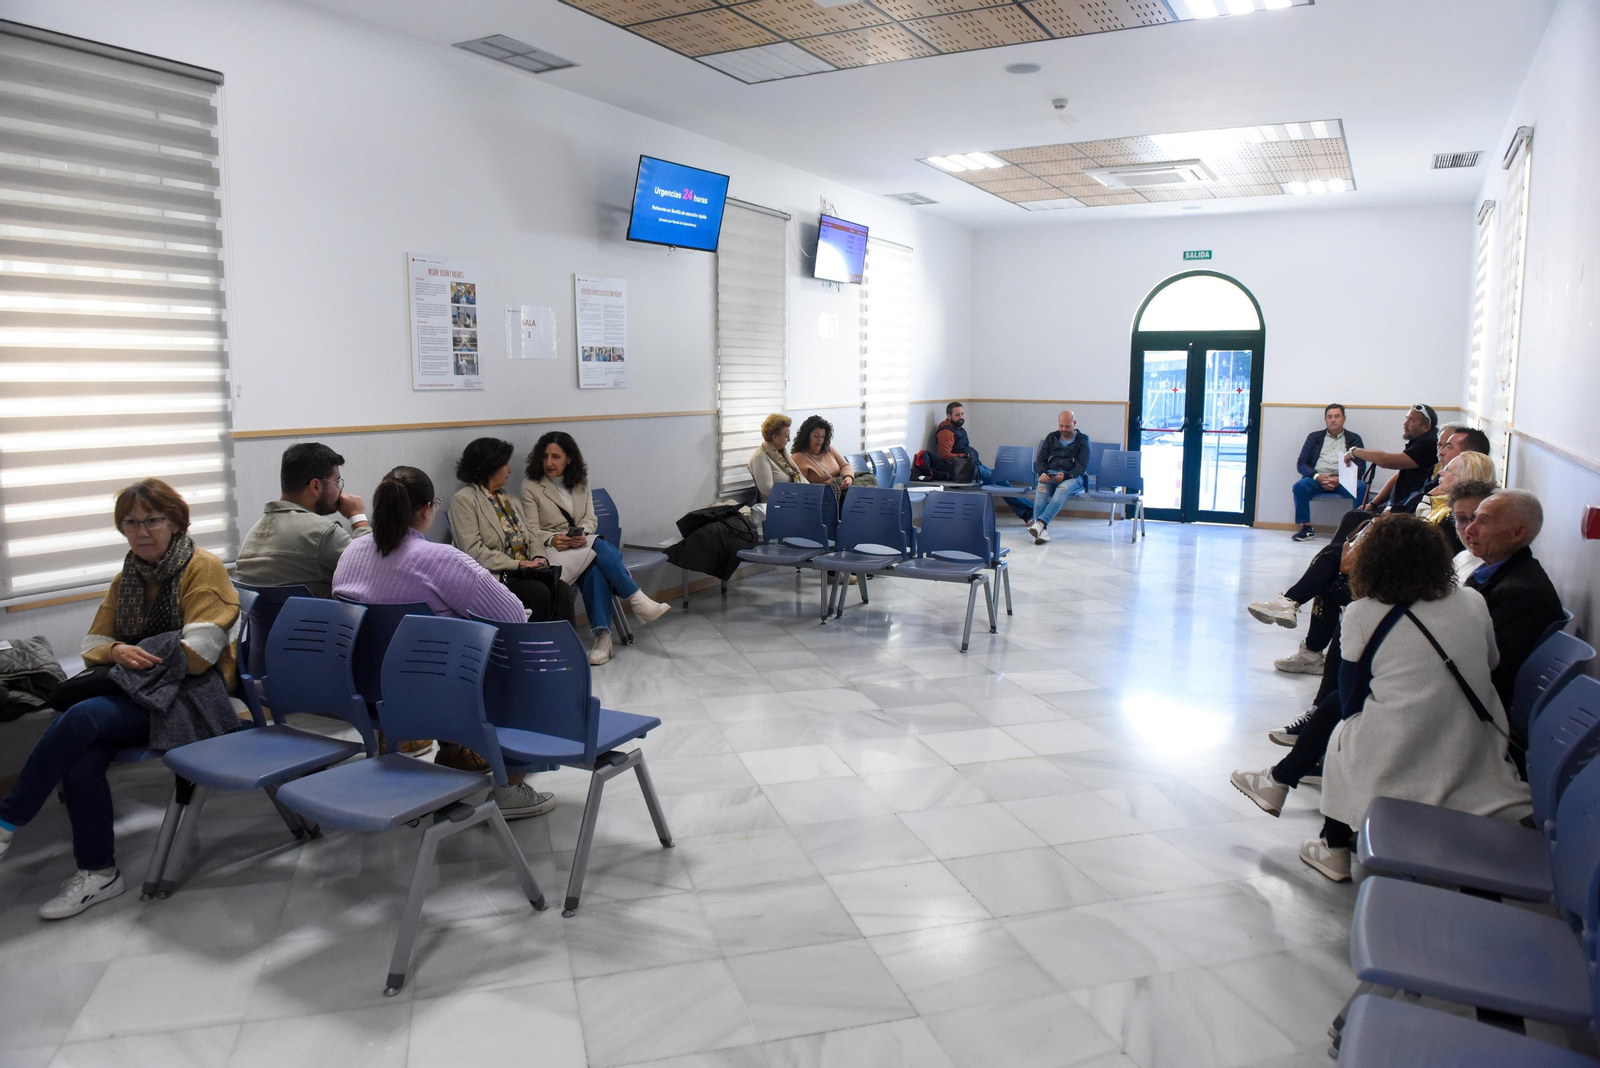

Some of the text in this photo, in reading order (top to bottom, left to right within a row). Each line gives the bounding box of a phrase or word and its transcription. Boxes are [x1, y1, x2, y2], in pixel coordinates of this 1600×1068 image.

[654, 186, 708, 204] Urgencias 24 horas
